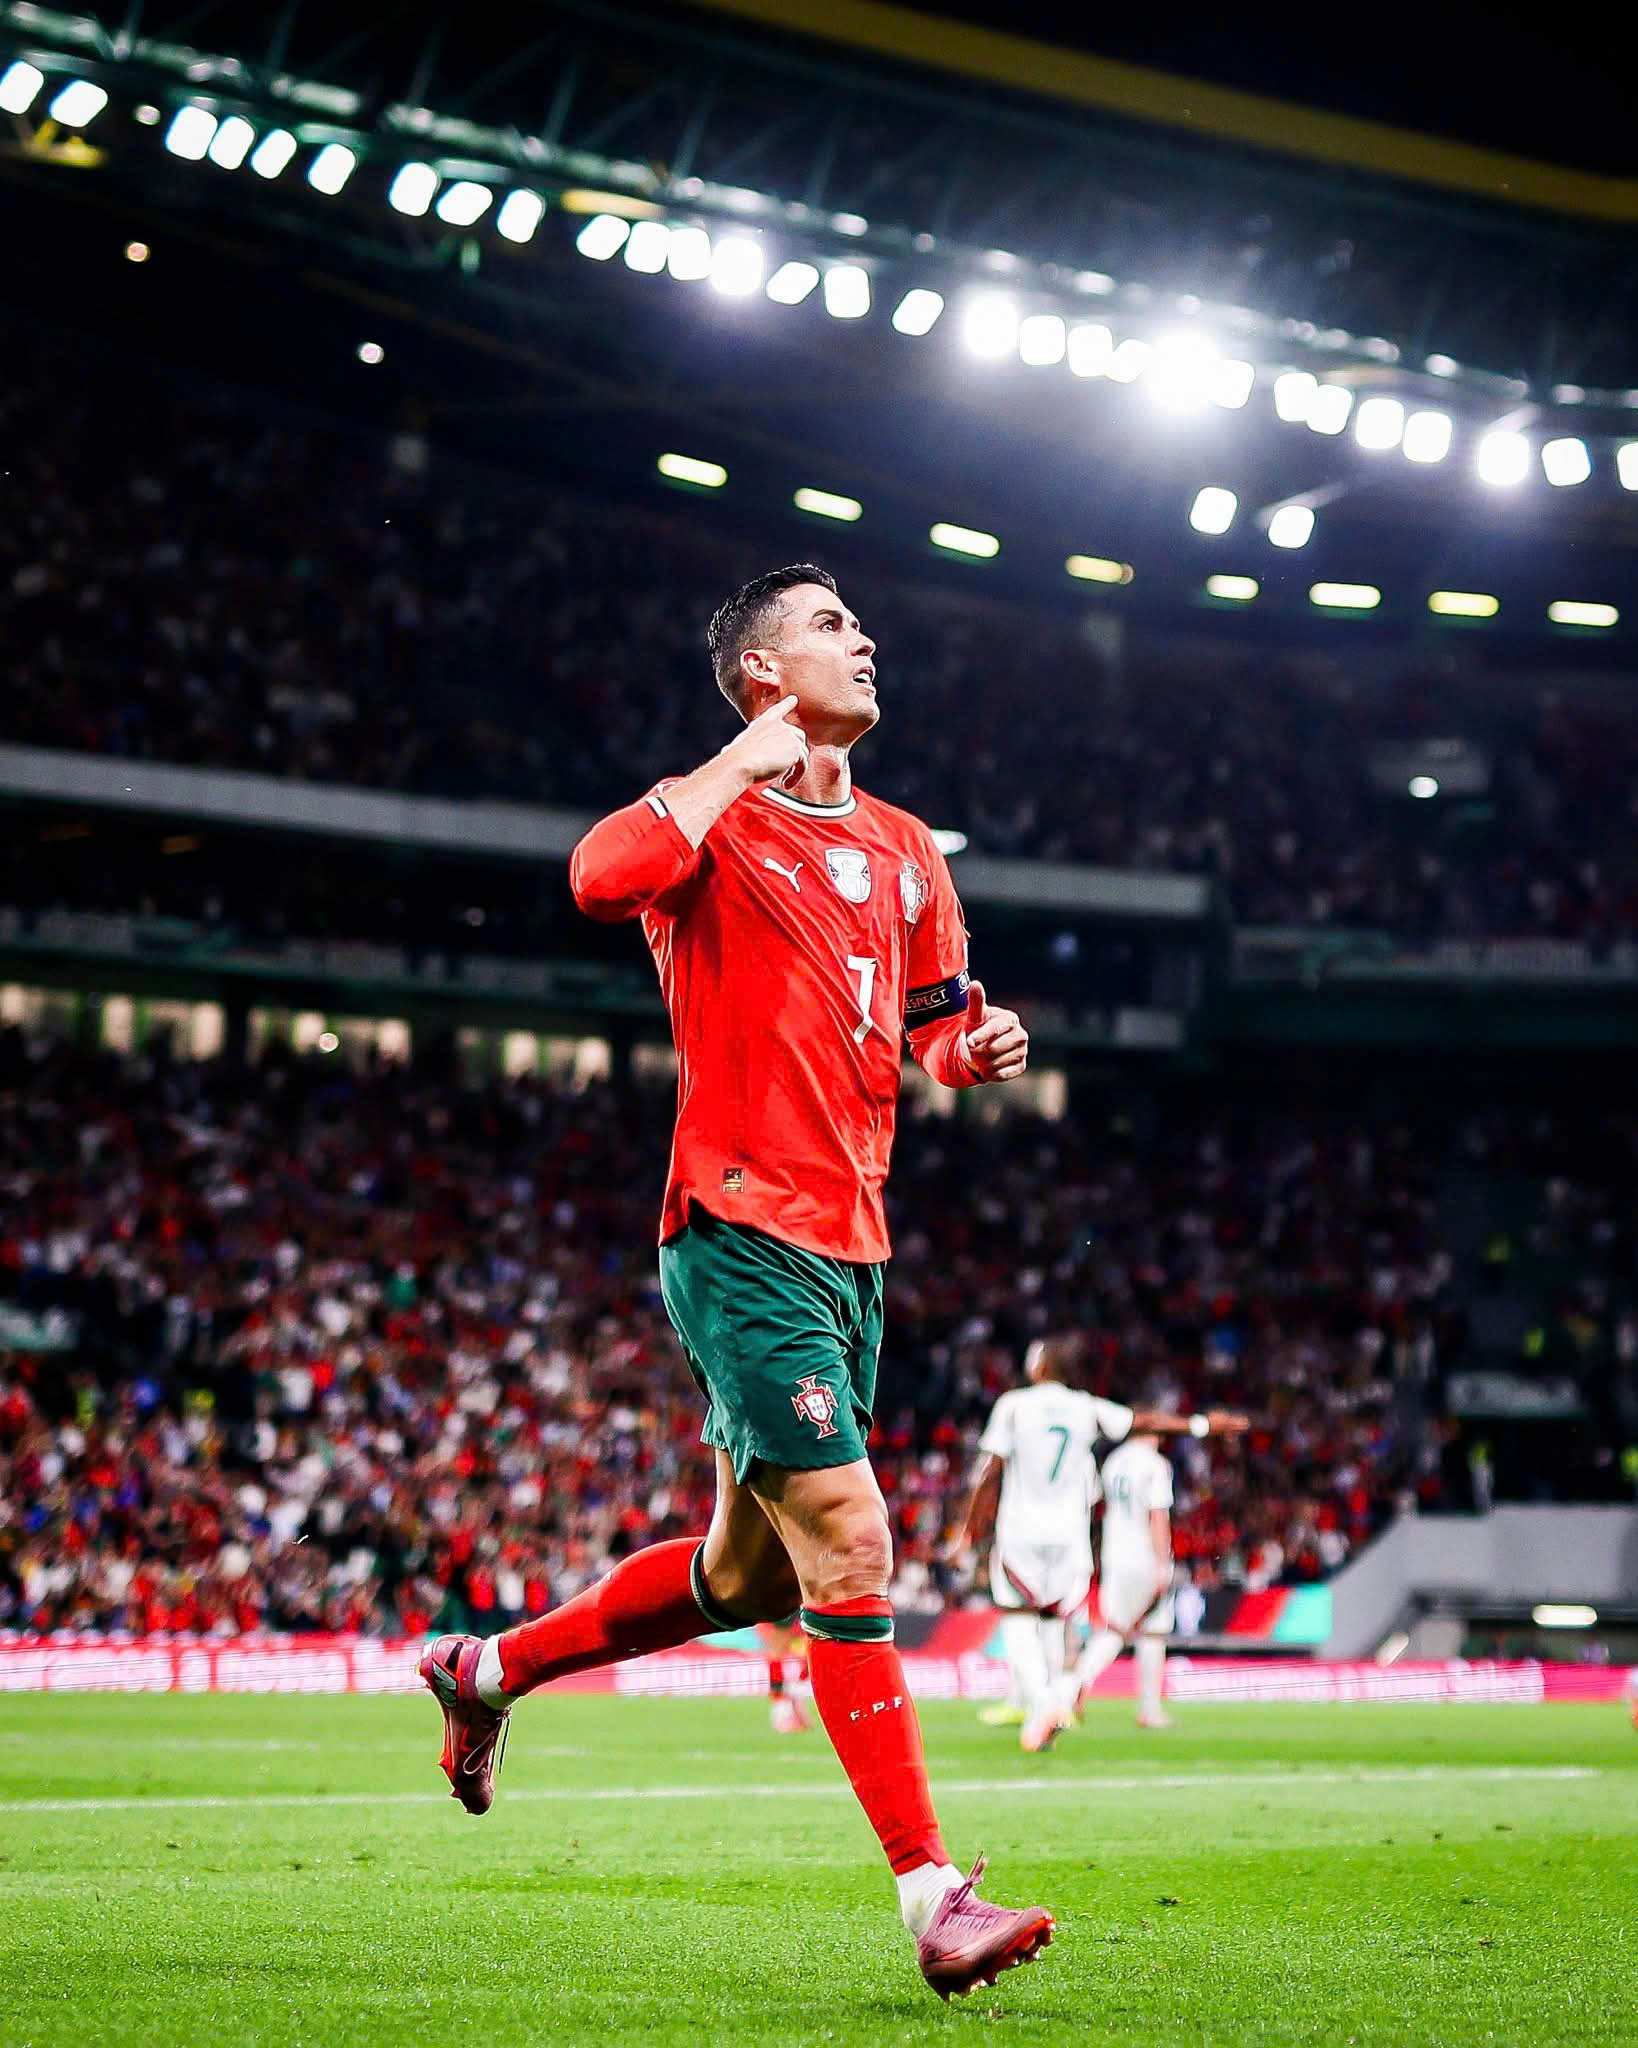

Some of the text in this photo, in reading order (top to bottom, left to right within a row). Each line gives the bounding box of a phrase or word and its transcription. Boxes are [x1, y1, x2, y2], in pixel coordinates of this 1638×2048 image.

[846, 954, 878, 1044] 7
[904, 988, 947, 1009] ESPECT
[1048, 1425, 1070, 1484] 7
